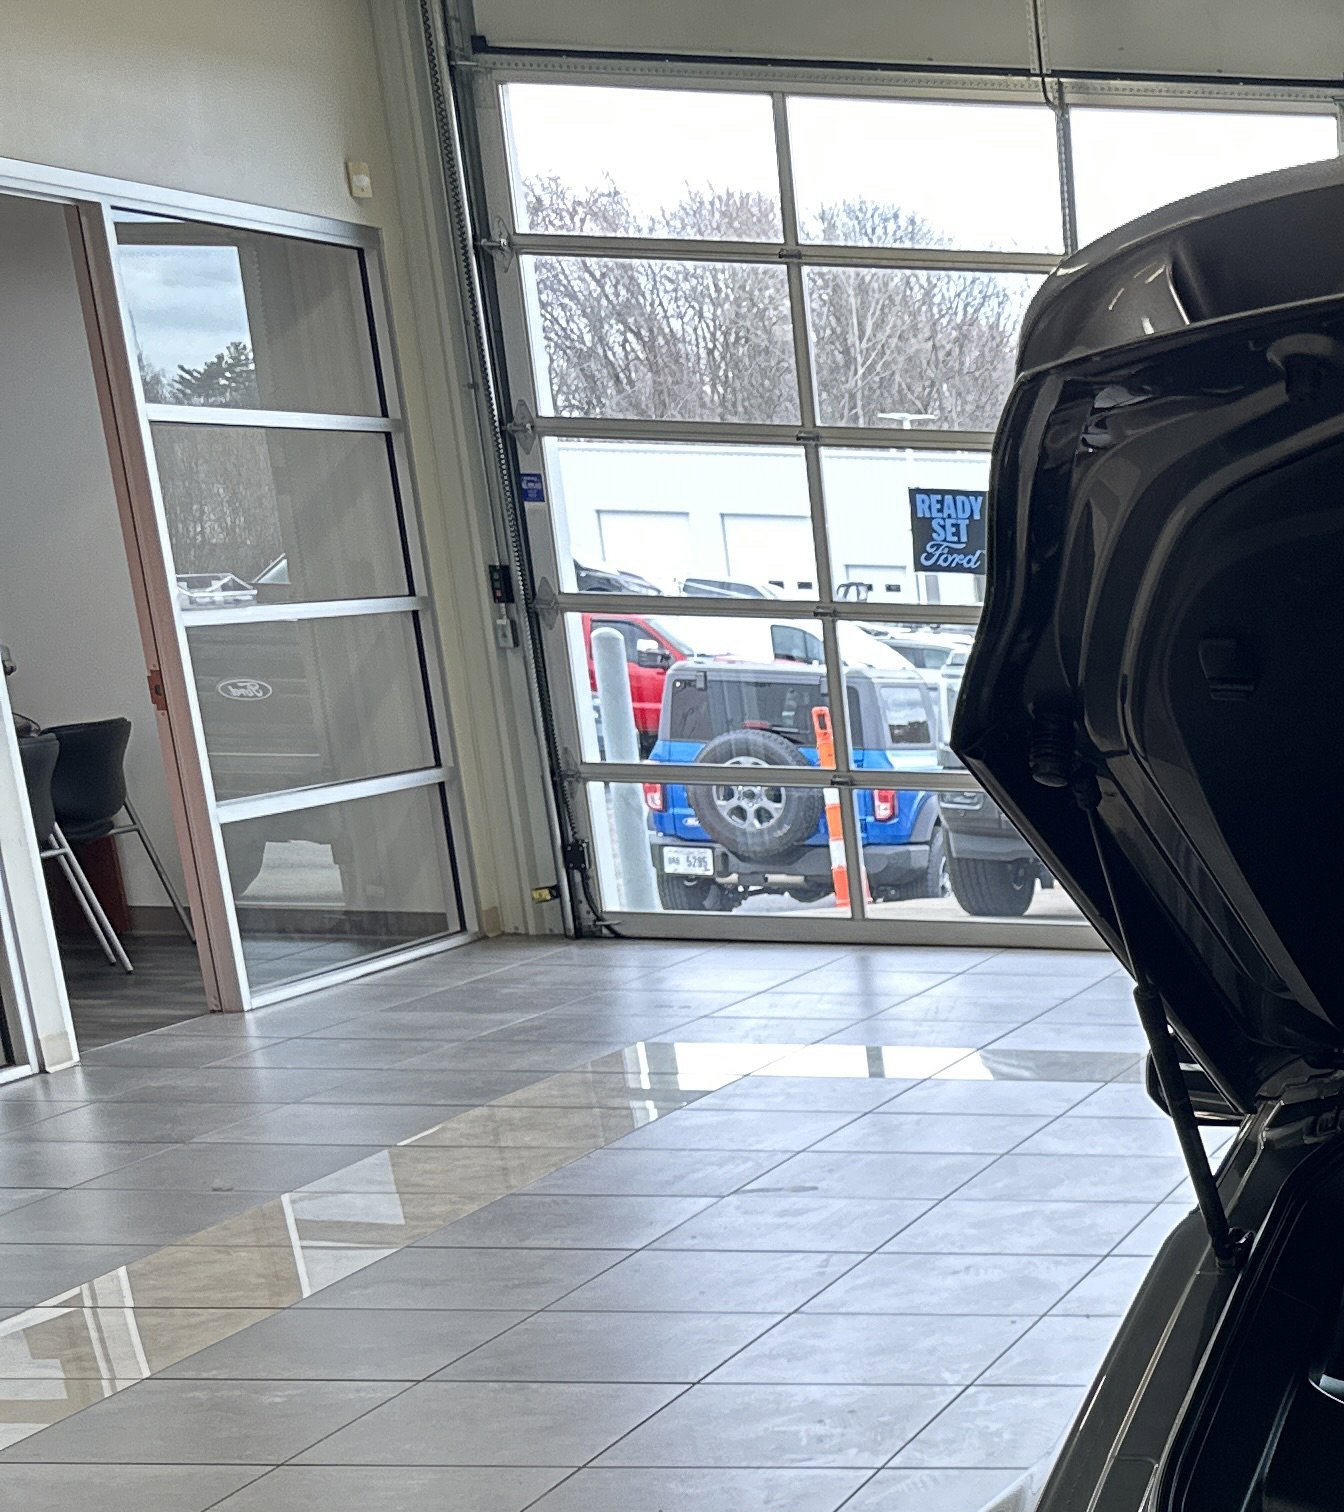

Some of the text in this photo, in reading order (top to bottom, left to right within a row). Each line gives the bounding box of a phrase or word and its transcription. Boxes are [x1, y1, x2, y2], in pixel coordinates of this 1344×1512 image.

[915, 494, 983, 520] READY
[931, 519, 970, 543] SET
[920, 541, 981, 569] Ford
